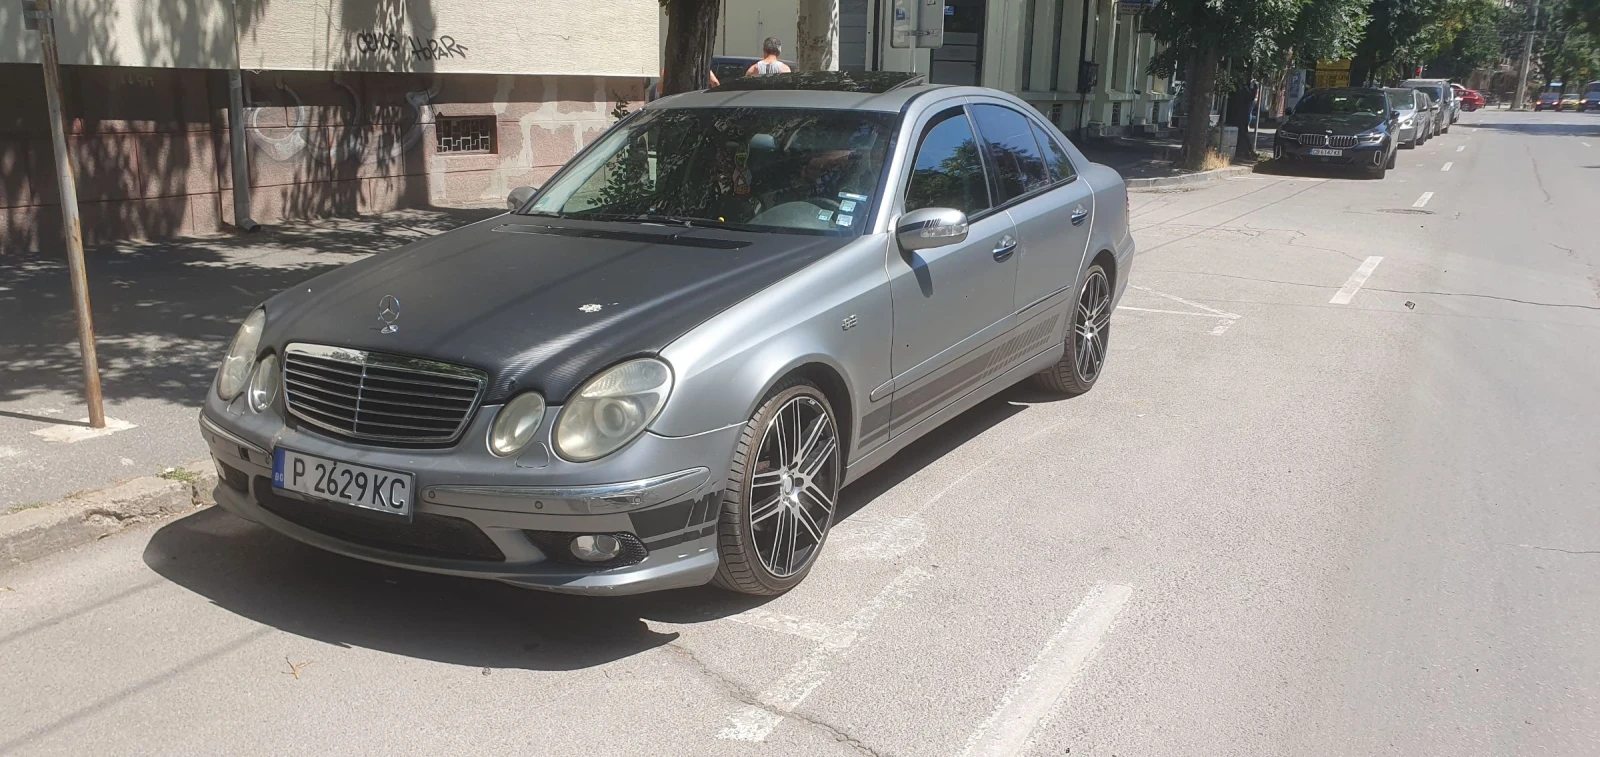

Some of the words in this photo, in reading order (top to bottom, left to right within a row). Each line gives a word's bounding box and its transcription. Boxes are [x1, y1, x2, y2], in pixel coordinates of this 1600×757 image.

[274, 472, 284, 482] BG
[293, 457, 306, 486] P
[314, 463, 368, 501] 2629
[372, 474, 406, 509] KC
